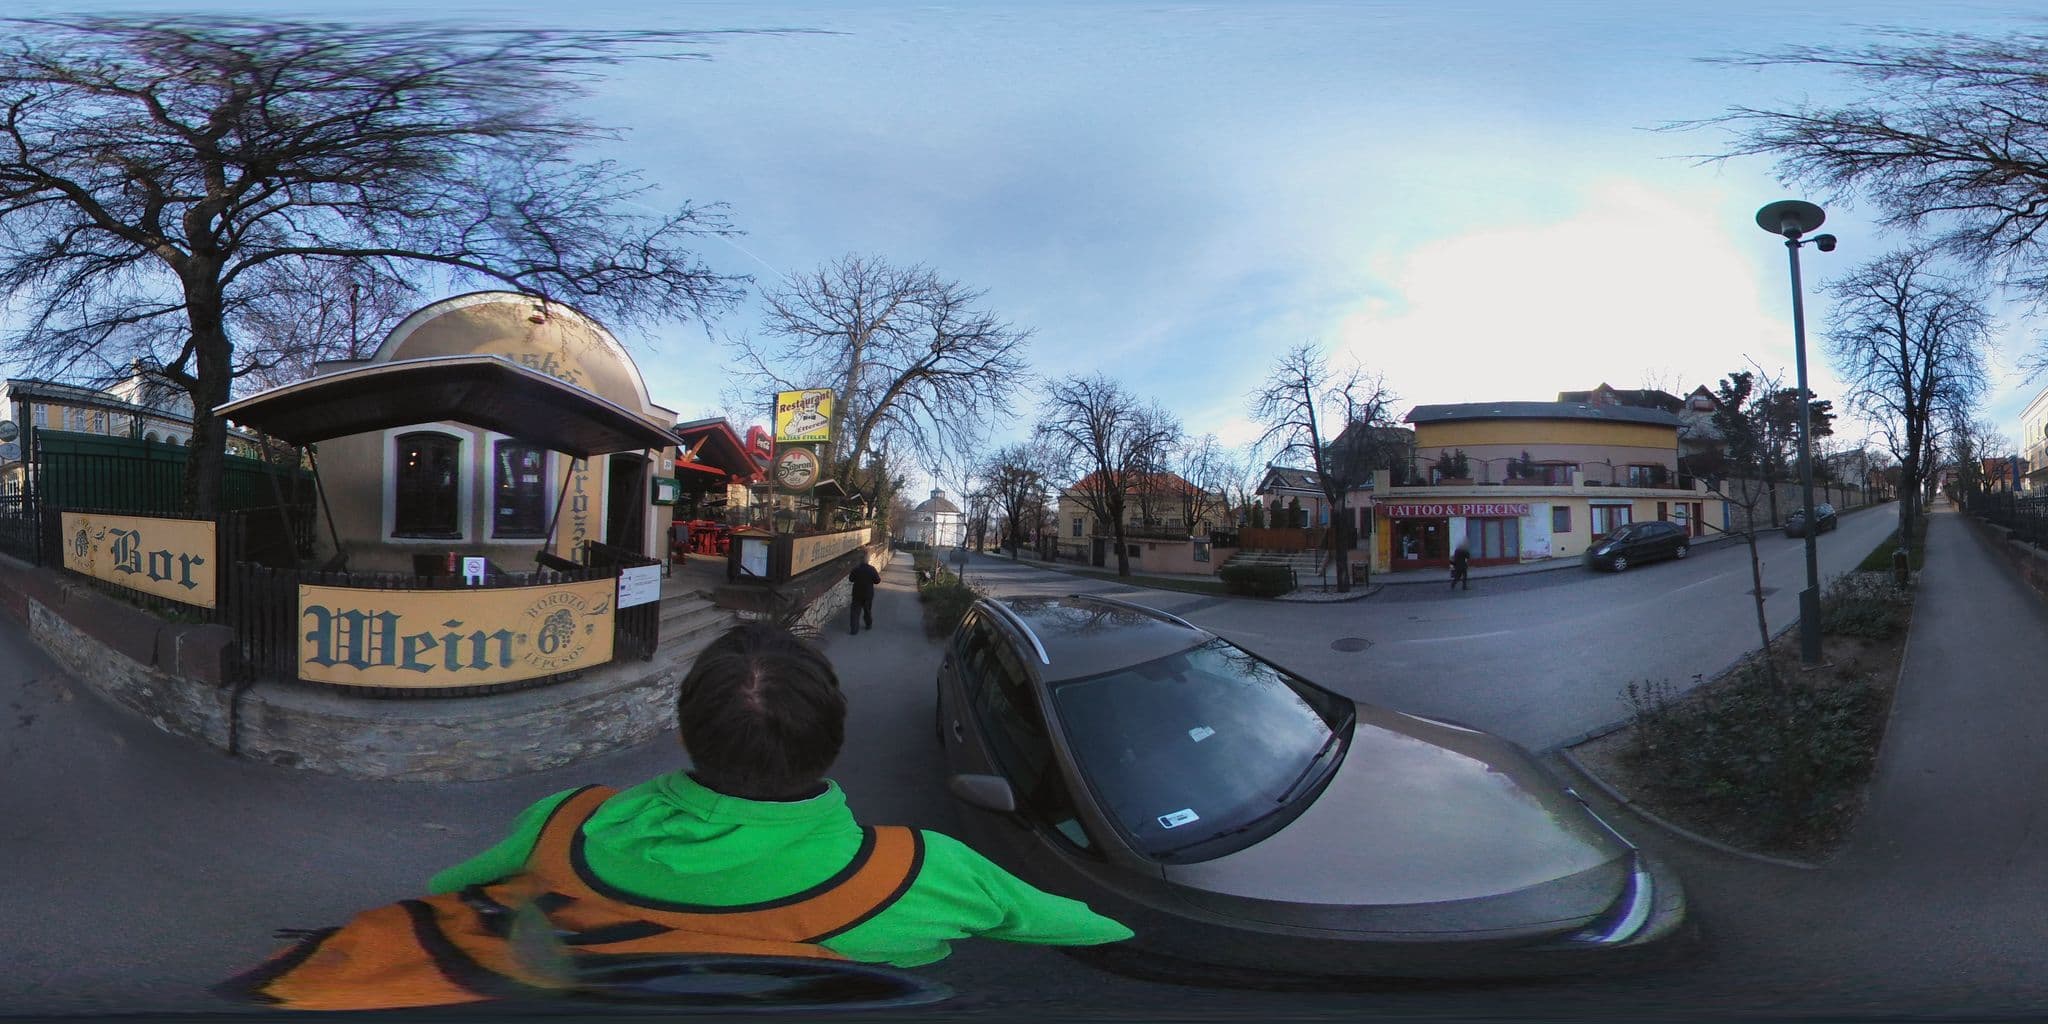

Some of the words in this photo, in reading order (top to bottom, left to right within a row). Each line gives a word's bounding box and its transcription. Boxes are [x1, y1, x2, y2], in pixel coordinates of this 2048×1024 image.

[779, 391, 829, 413] Restaurant
[1387, 504, 1443, 516] TATTOO
[1446, 505, 1456, 515] &
[1462, 504, 1528, 516] PIERCING
[108, 527, 205, 590] Bor
[303, 605, 515, 674] Wein
[538, 624, 560, 655] 6
